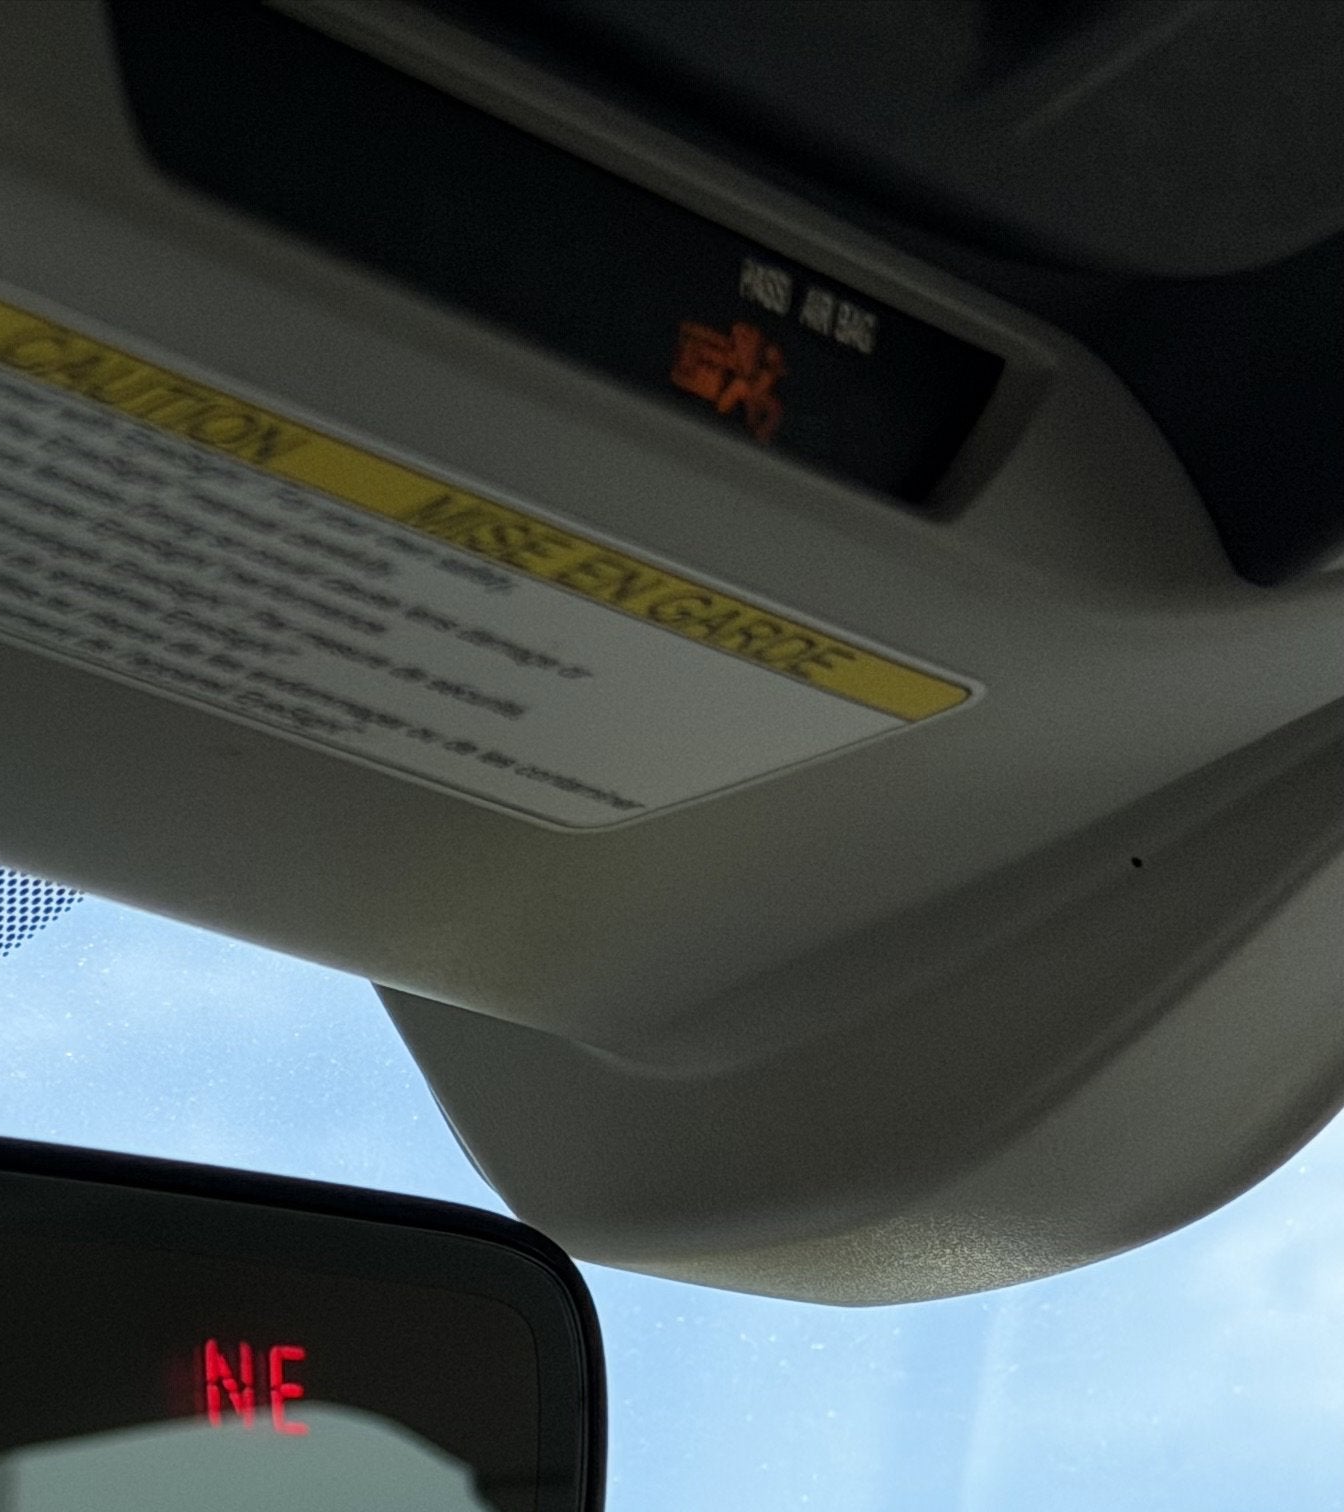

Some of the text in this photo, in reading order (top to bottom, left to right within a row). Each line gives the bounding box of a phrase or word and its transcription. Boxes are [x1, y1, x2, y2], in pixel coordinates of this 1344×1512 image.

[404, 492, 574, 570] MISE
[554, 550, 658, 606] EN
[643, 593, 857, 680] GARDE
[205, 1338, 309, 1436] NE
